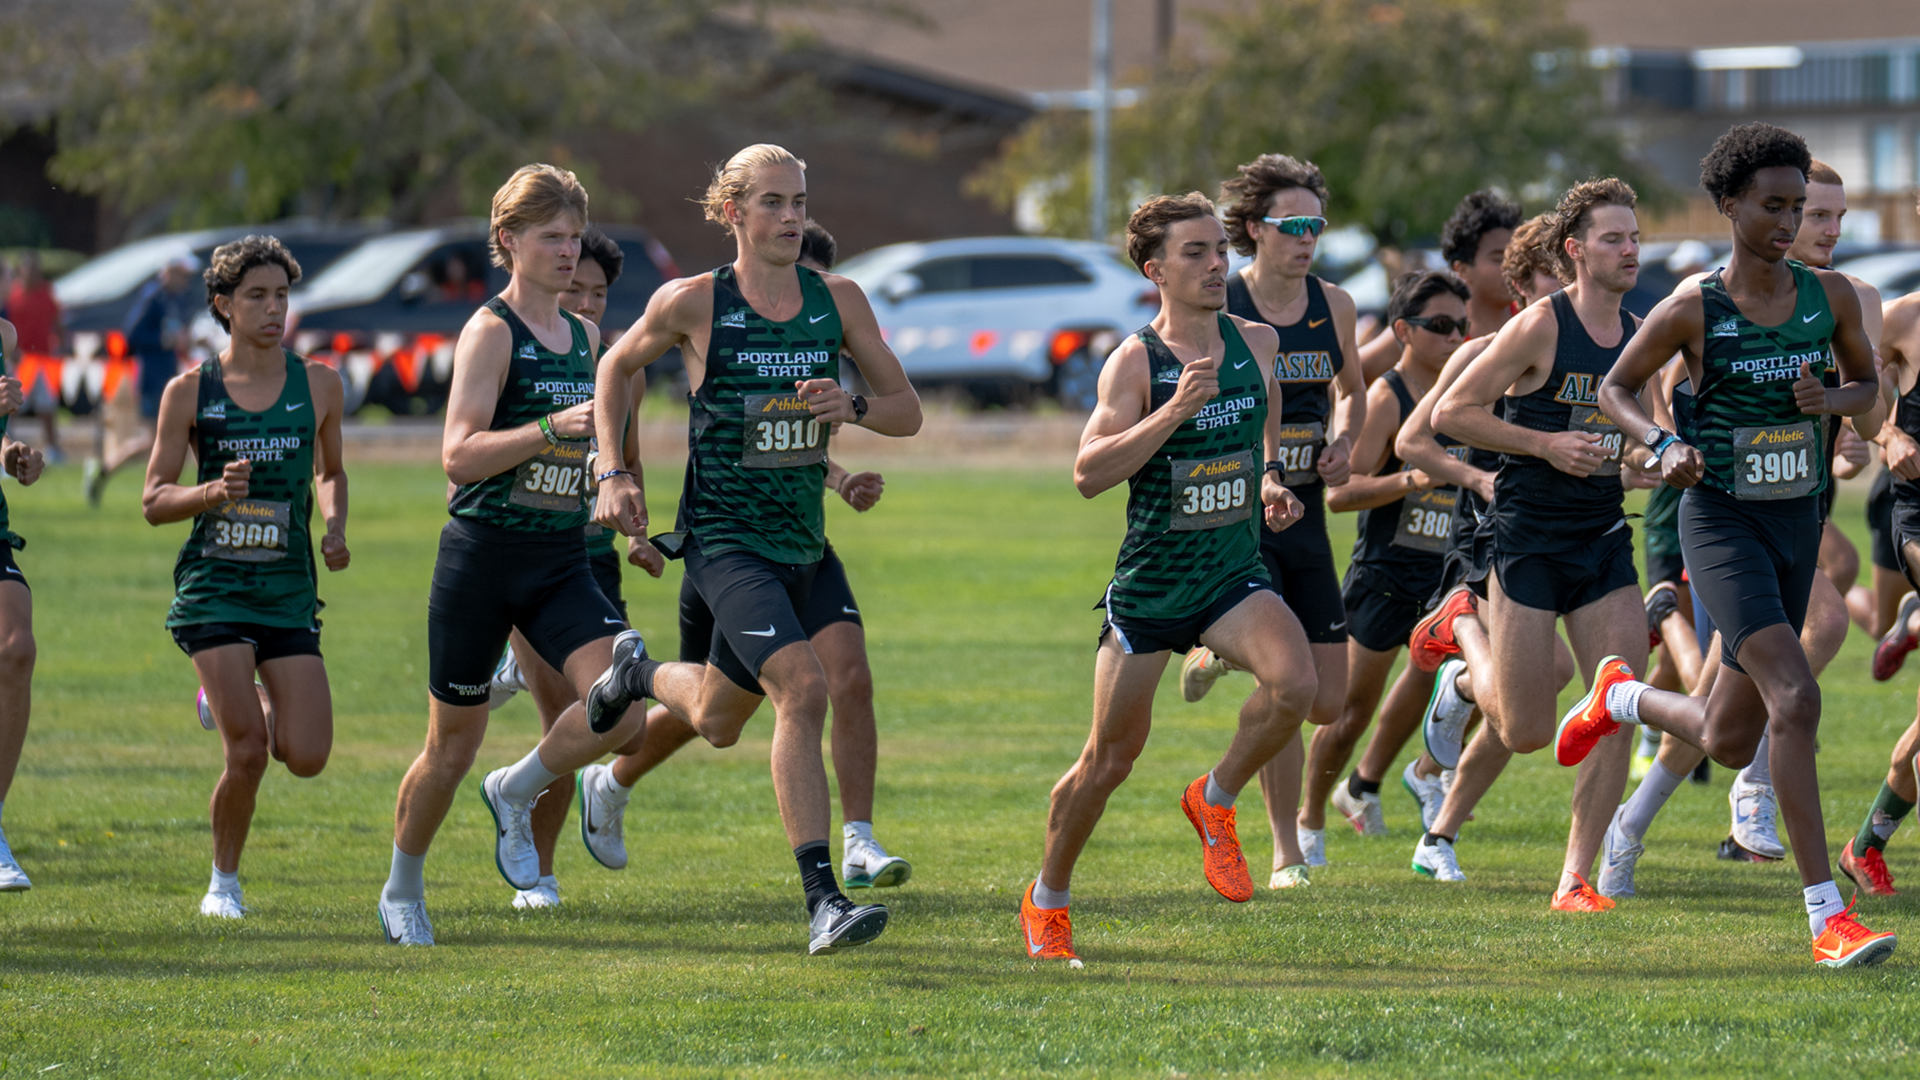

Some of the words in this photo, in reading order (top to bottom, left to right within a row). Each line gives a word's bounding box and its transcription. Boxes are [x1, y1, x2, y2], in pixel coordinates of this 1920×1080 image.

[736, 351, 829, 364] PORTLAND
[1273, 353, 1334, 381] ASKA
[1731, 351, 1822, 374] PORTLAND
[757, 365, 812, 377] STATE
[1557, 373, 1605, 405] AL
[1192, 396, 1255, 418] RTLAND
[1196, 411, 1241, 431] STATE
[217, 436, 301, 451] PORTLAND
[756, 419, 820, 451] 3910
[1750, 429, 1805, 445] Athletic
[236, 449, 285, 461] STATE
[539, 444, 584, 459] Athletic
[1189, 460, 1241, 478] Athletic
[1745, 448, 1810, 484] 3904
[524, 462, 583, 497] 3902
[1182, 477, 1247, 515] 3899
[221, 501, 276, 518] Athletic
[1407, 507, 1453, 538] 380
[215, 520, 280, 549] 3900
